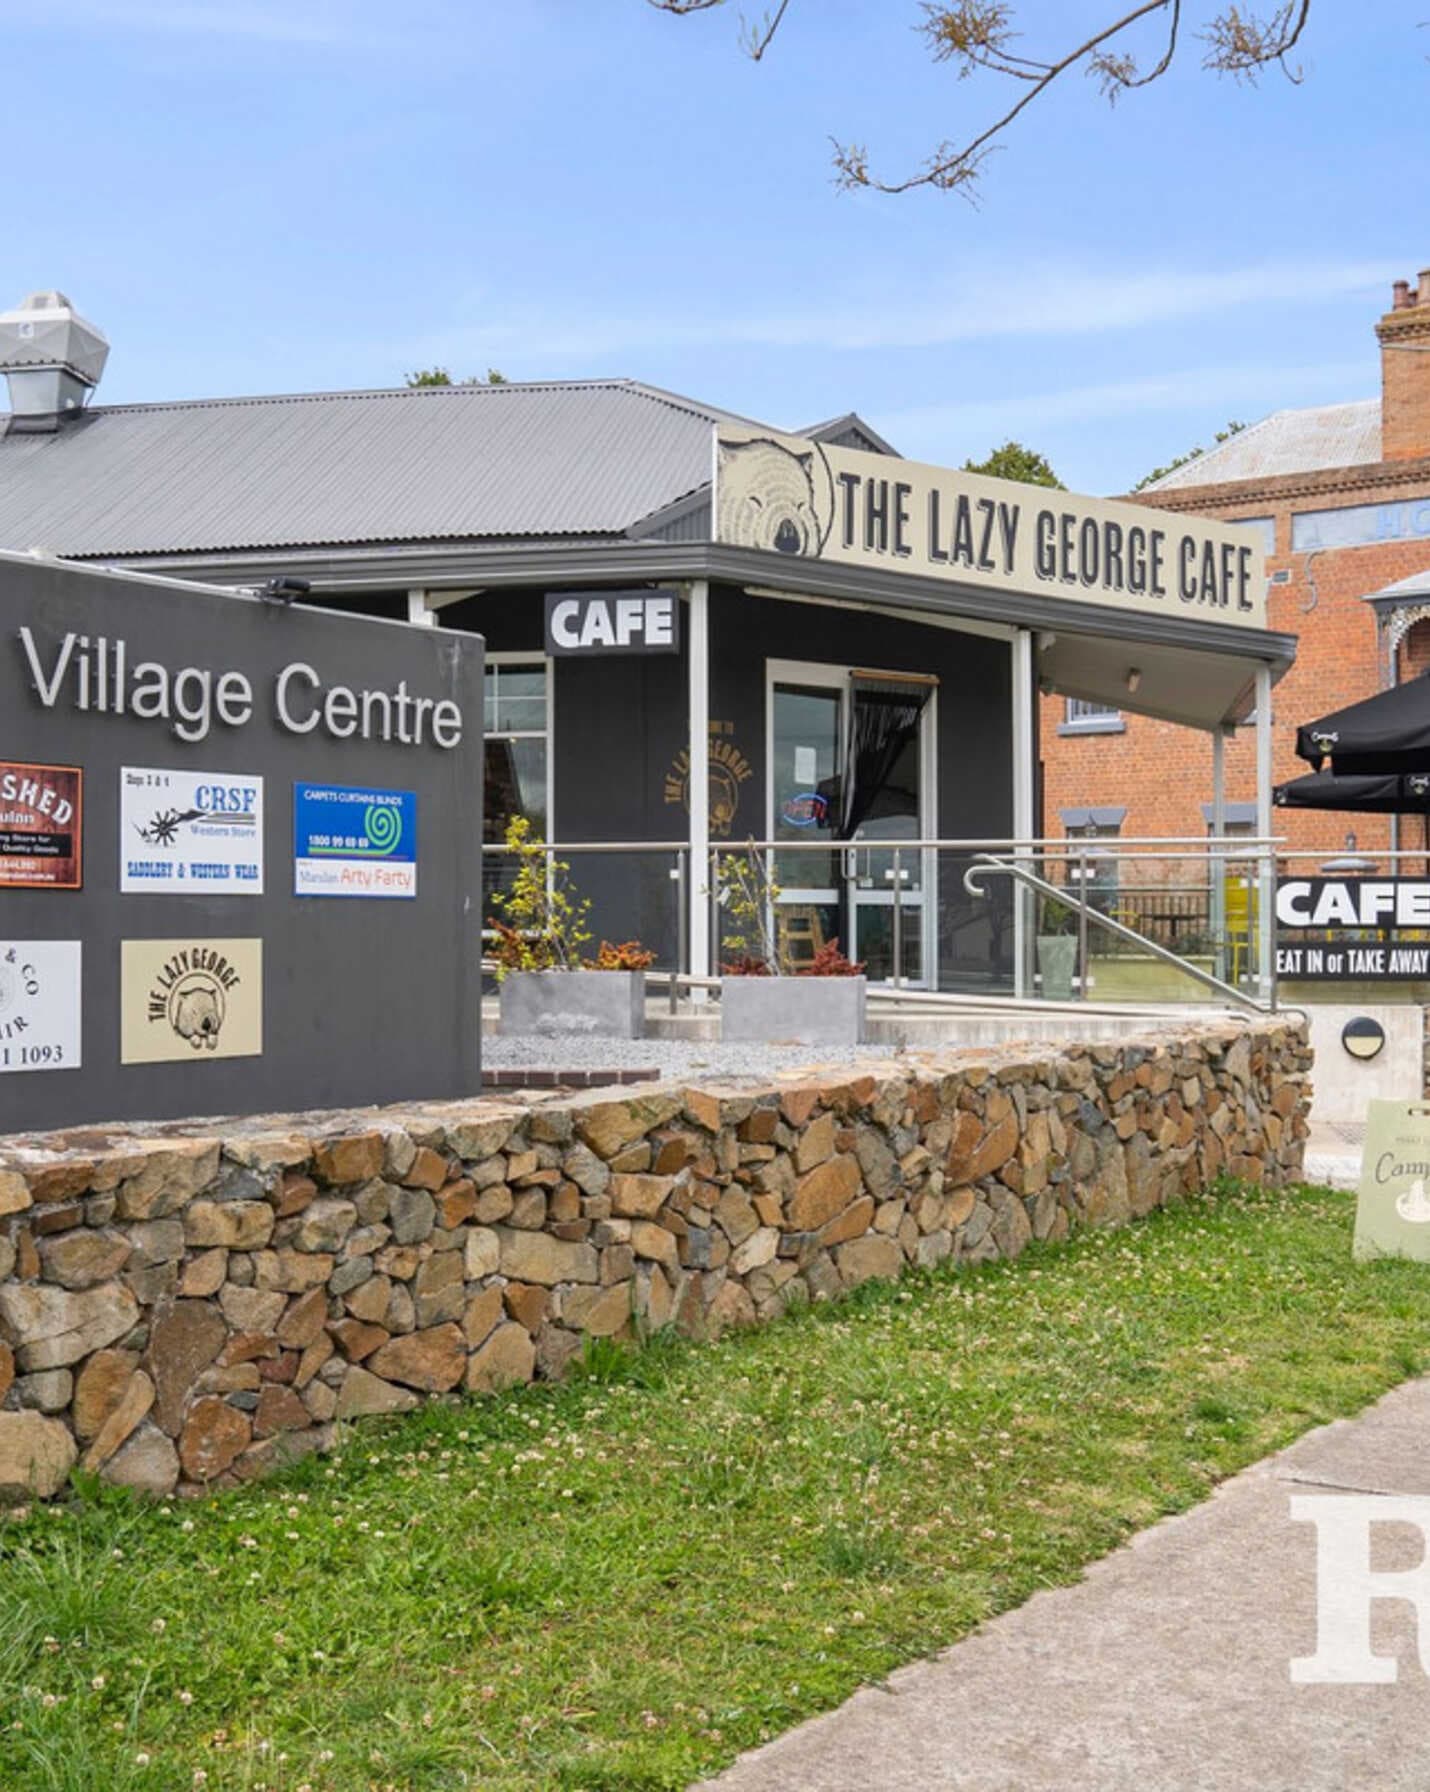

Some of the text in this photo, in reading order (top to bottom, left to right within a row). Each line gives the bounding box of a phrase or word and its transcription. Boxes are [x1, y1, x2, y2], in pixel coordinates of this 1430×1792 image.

[838, 472, 1254, 611] THE LAZY GEORGE CAFE
[551, 598, 672, 648] CAFE
[18, 626, 463, 749] Village Centre
[1, 774, 73, 825] SHED
[195, 785, 257, 812] CRSF
[304, 790, 337, 801] CARPETS
[377, 795, 403, 806] BLINDS
[664, 773, 683, 804] THE
[784, 799, 826, 820] OPEN
[128, 861, 259, 879] SADDLERY & WESTERN WEAR
[340, 867, 371, 886] Arty
[374, 868, 410, 889] Farty
[1276, 881, 1430, 926] CAFE
[4, 947, 40, 995] & CO
[1276, 949, 1429, 973] EAT IN or TAKE AWAY
[148, 947, 241, 1023] THE LAZY GEORGE
[0, 1016, 29, 1039] IR
[21, 1045, 64, 1064] 1093
